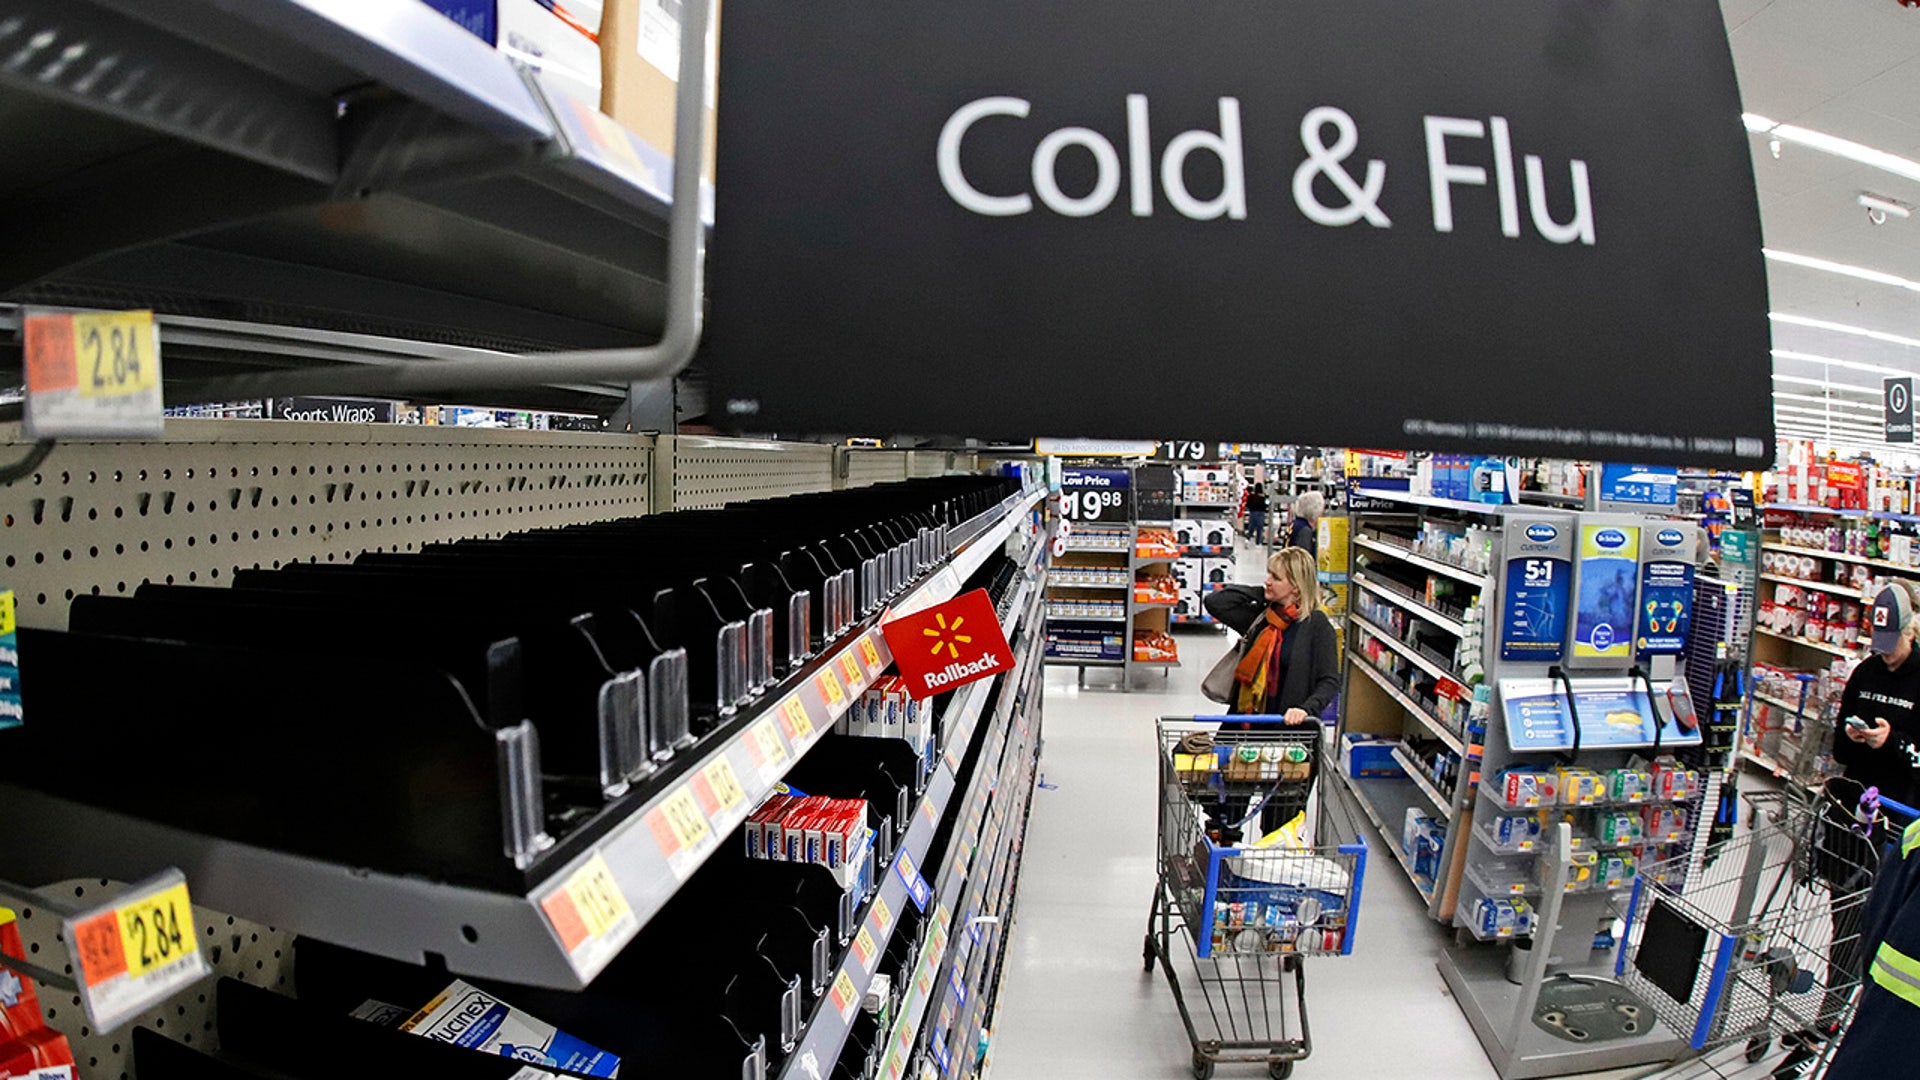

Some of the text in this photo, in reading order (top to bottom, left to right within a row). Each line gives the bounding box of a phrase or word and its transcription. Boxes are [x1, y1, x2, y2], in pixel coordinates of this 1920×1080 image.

[936, 94, 1596, 246] Cold & Flu
[83, 326, 141, 388] 2.84
[283, 404, 376, 422] Sports Wraps
[1062, 475, 1111, 487] Low Price
[1349, 499, 1395, 510] Low Price
[923, 652, 1001, 690] Rollback
[134, 901, 184, 967] 2.84
